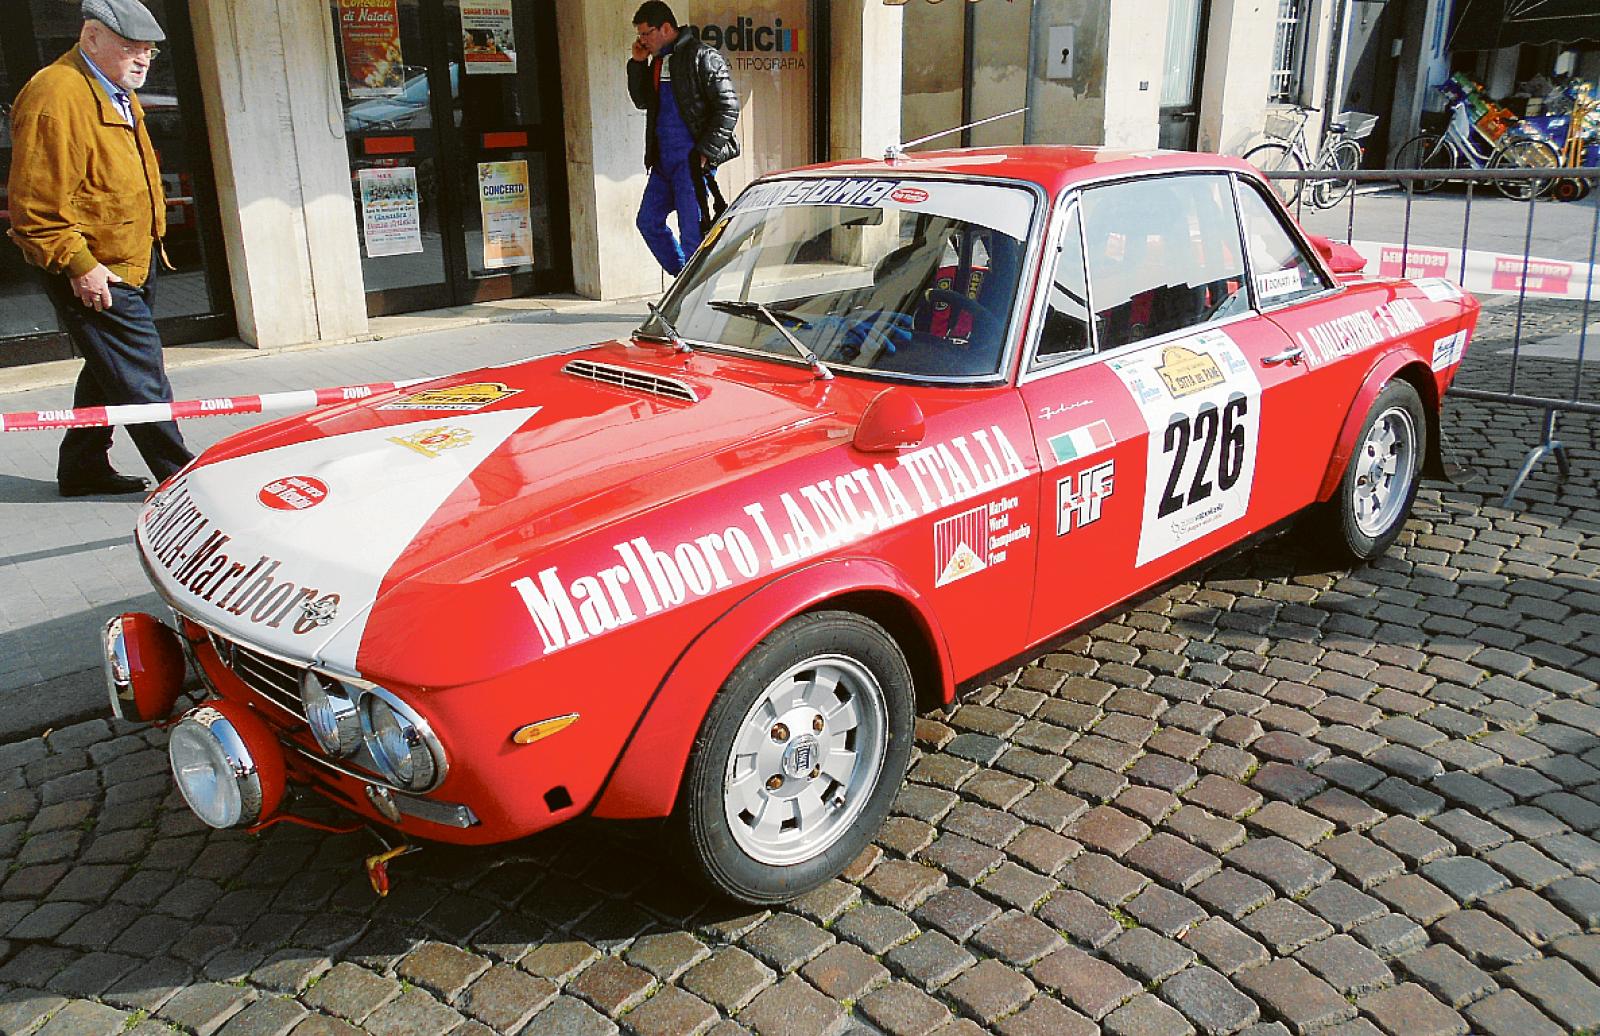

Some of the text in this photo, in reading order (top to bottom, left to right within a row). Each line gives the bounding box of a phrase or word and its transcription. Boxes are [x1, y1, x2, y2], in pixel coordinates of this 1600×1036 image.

[343, 8, 393, 22] di Natale
[688, 16, 783, 52] edici
[736, 57, 806, 71] TIPOGRAFIA
[483, 183, 525, 196] CONCERTO
[340, 385, 371, 400] ZONA
[200, 398, 234, 411] ZONA
[37, 409, 76, 422] ZONA
[1157, 391, 1247, 519] 226
[1056, 458, 1116, 538] HF
[510, 424, 1030, 655] Marlboro LANCIA ITALIA
